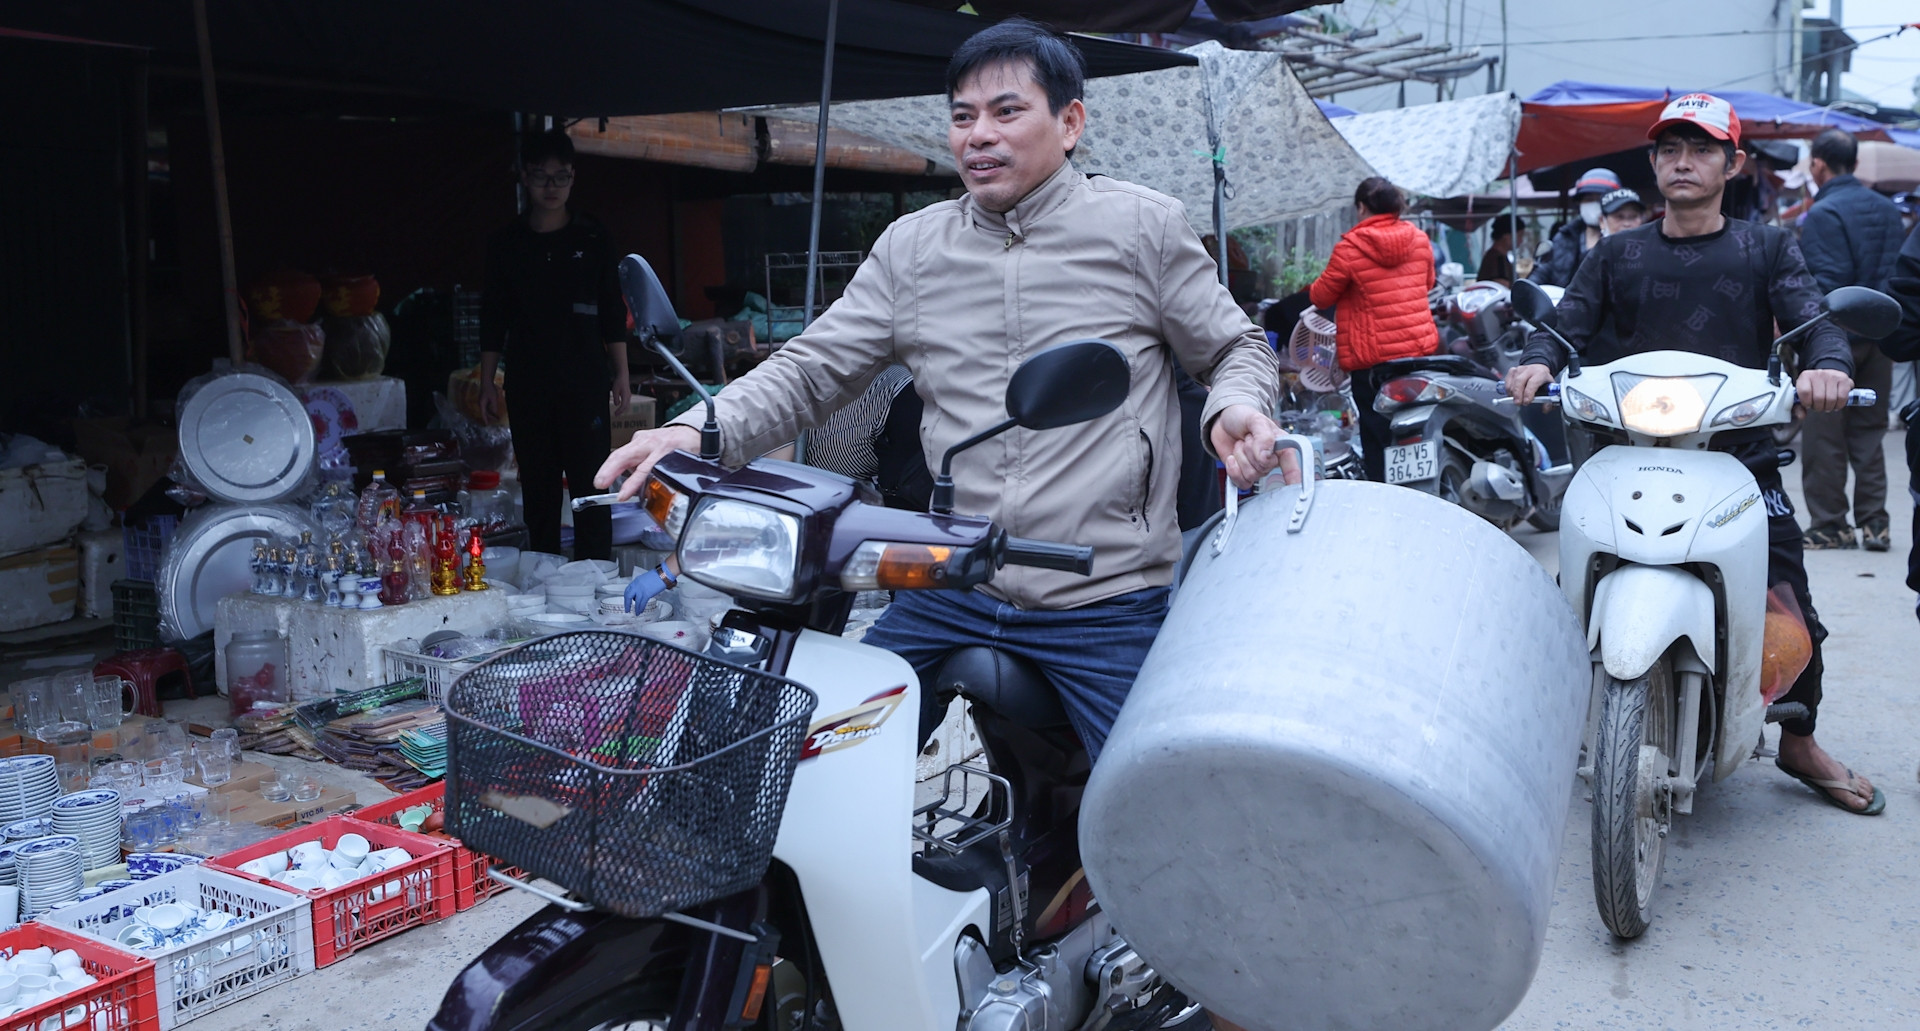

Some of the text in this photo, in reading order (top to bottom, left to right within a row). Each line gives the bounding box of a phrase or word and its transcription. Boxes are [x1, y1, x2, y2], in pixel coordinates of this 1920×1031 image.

[1392, 443, 1428, 465] 29-V5
[1388, 460, 1433, 483] 364.57
[1637, 465, 1684, 475] HONDA
[808, 727, 881, 751] DREAM
[300, 806, 325, 820] VTC 56
